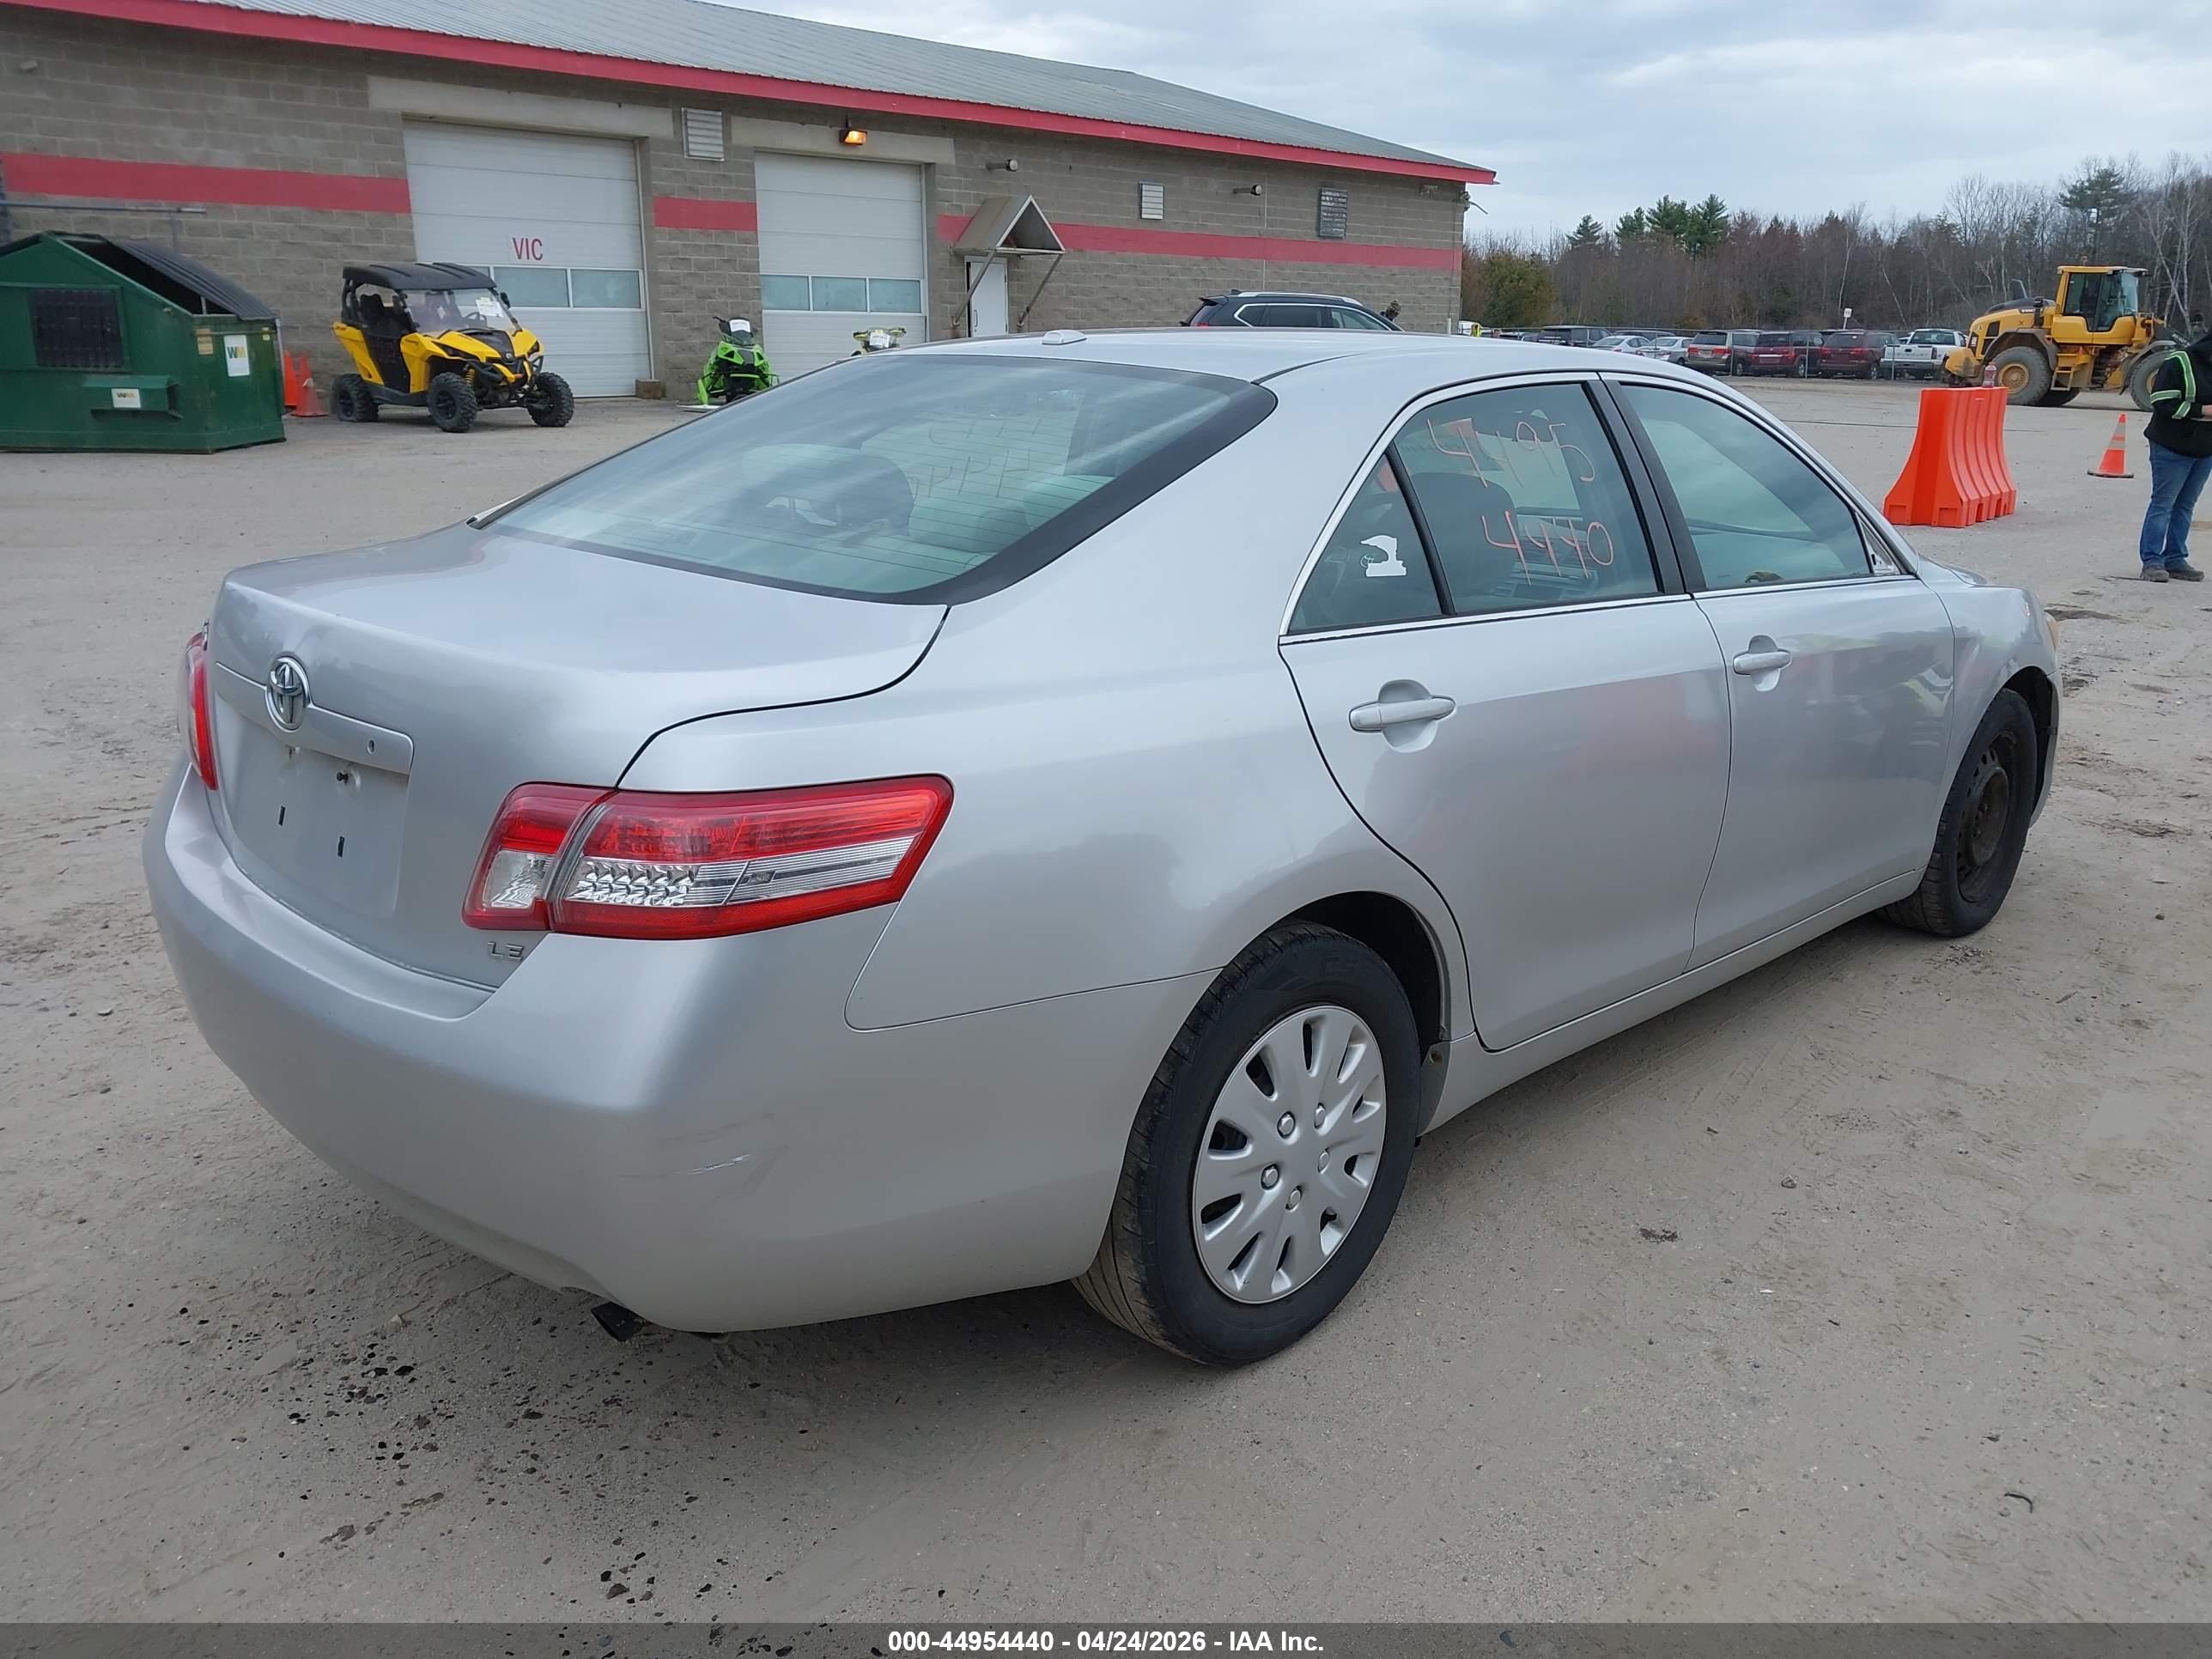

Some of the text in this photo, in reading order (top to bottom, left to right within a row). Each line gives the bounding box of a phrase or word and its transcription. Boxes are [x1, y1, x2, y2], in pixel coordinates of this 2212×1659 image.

[512, 237, 543, 260] VIC
[227, 346, 246, 359] WM
[1427, 418, 1595, 488] 4495
[1480, 510, 1614, 586] 4440
[487, 941, 524, 962] LE
